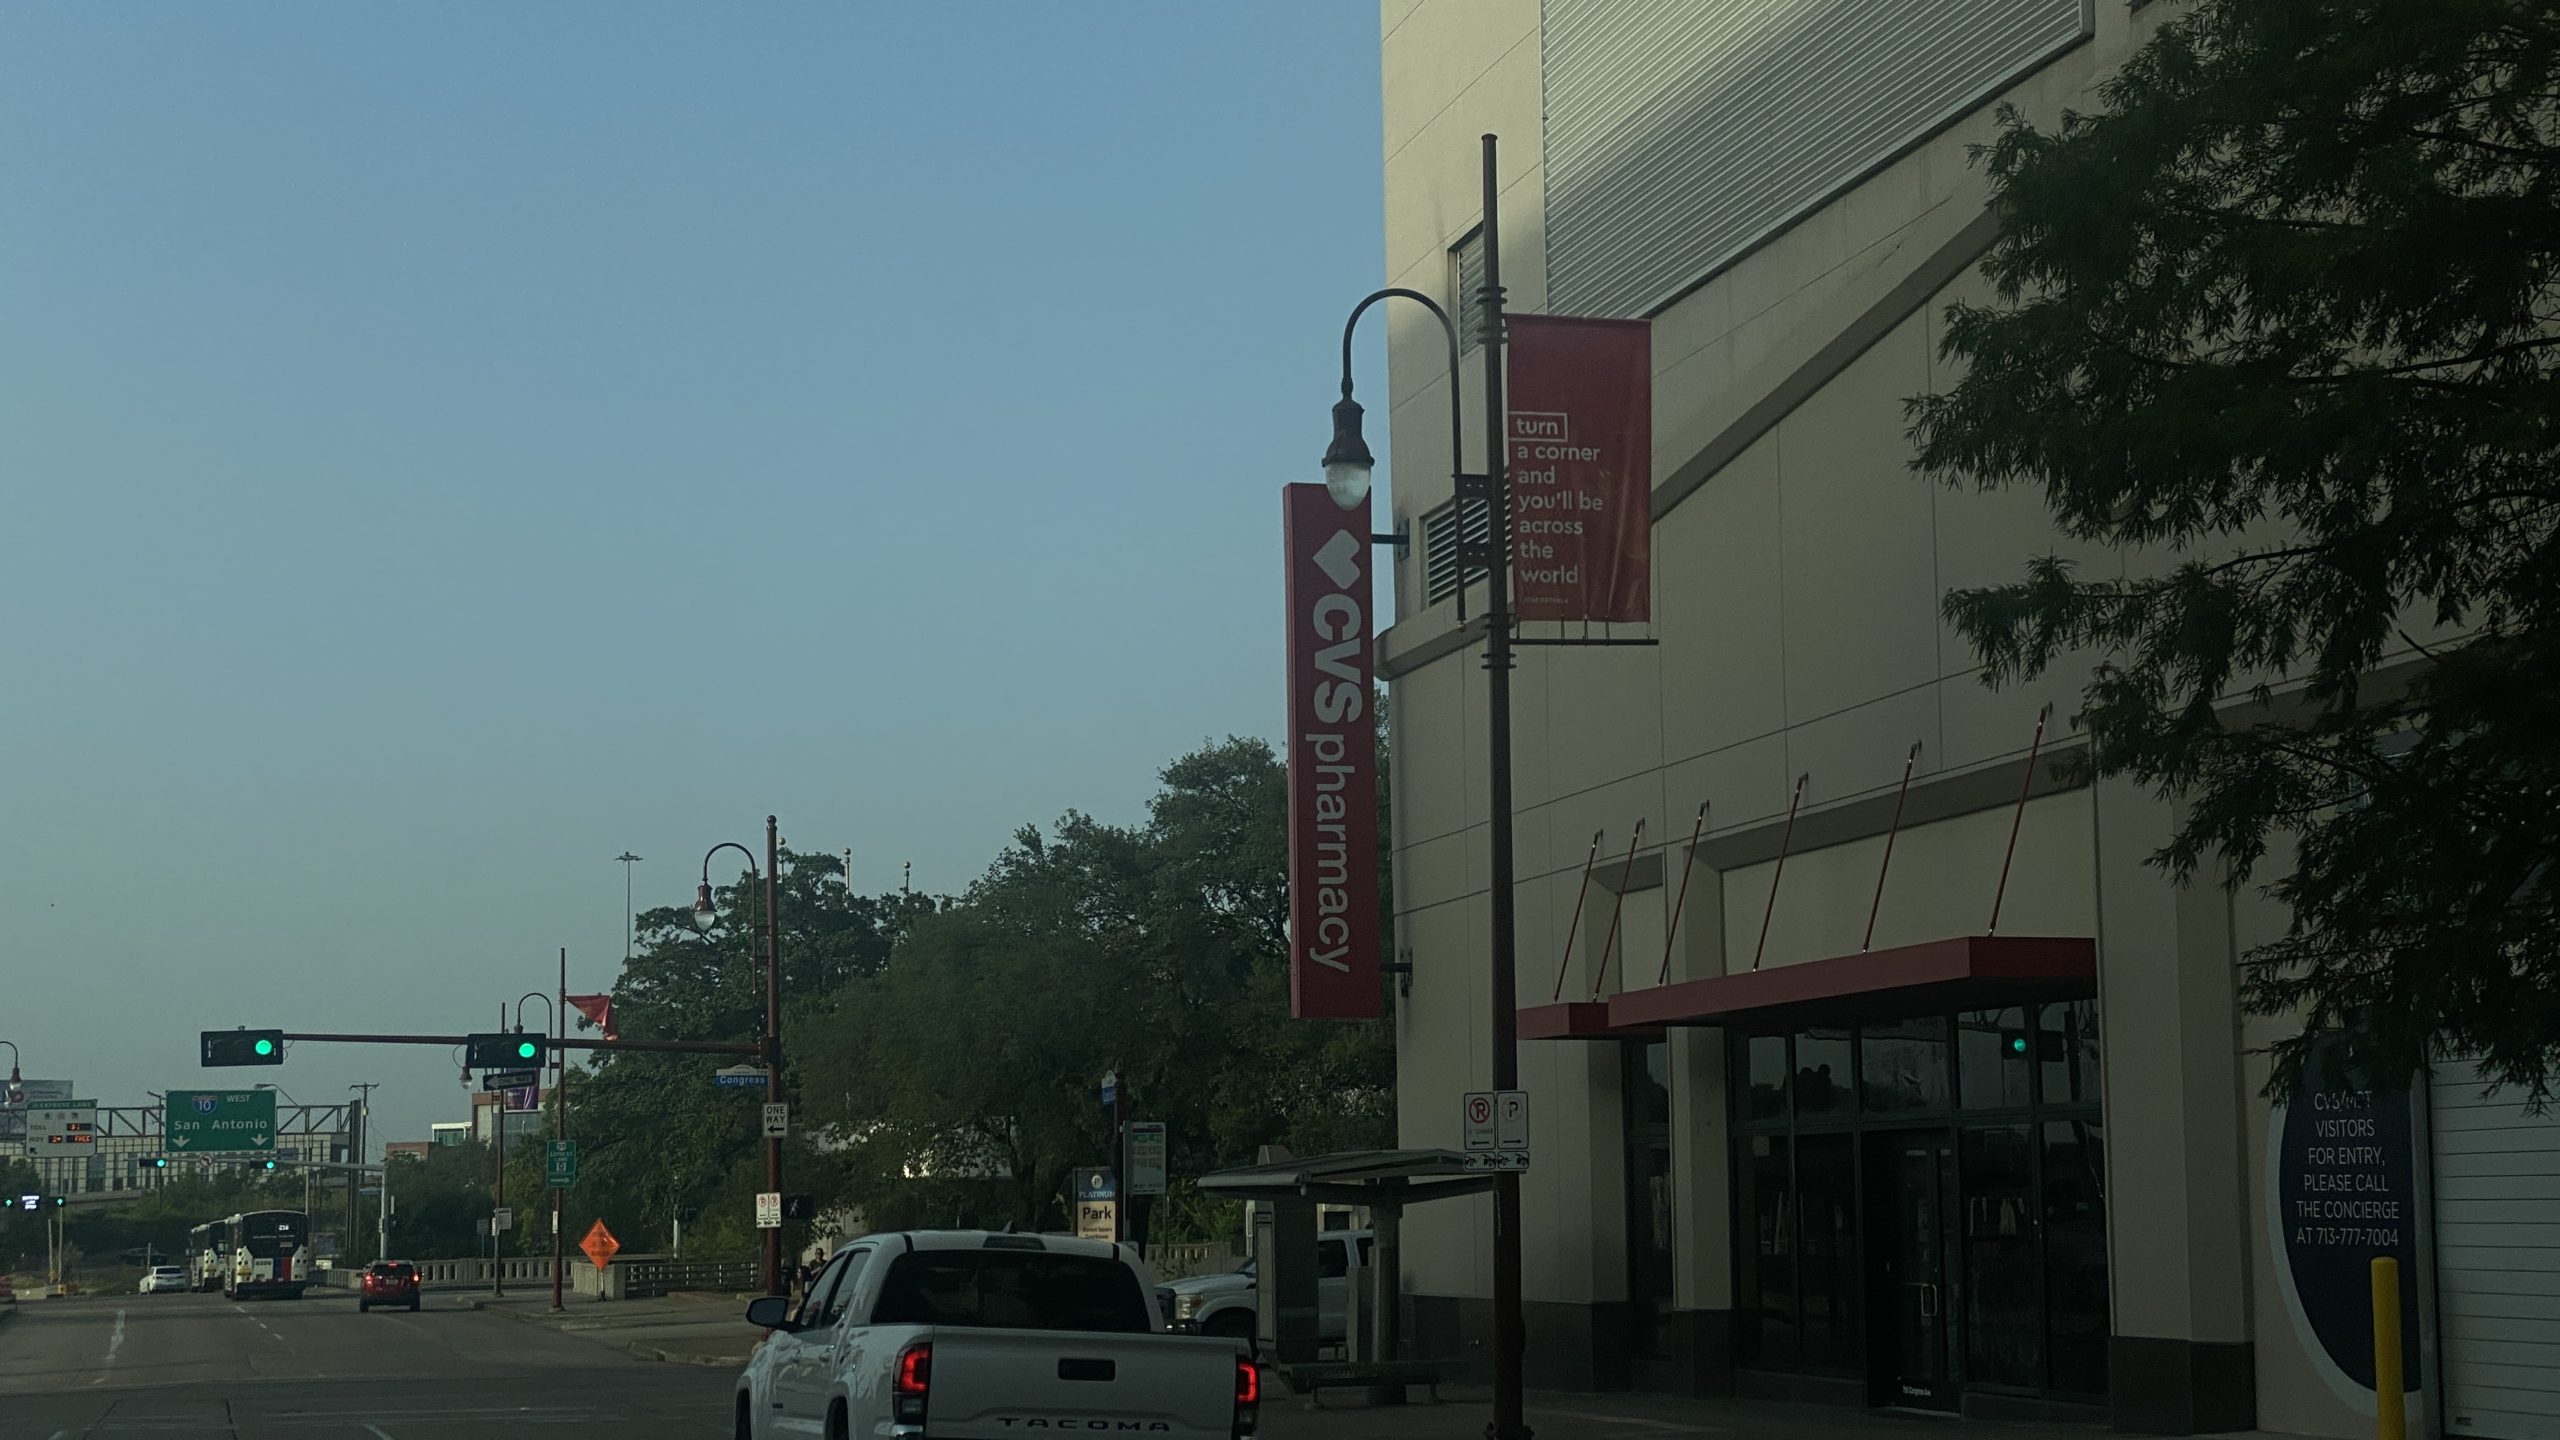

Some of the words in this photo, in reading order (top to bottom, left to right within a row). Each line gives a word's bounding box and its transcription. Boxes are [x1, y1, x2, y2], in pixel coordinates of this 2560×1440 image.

[1516, 418, 1558, 435] turn
[1517, 446, 1528, 459] a
[1535, 446, 1601, 460] corner
[1518, 465, 1555, 484] and
[1518, 491, 1572, 512] you'll
[1579, 491, 1604, 511] be
[1519, 520, 1584, 534] across
[1520, 540, 1554, 559] the
[1520, 565, 1578, 583] world
[1313, 593, 1363, 723] CVS
[1305, 734, 1355, 973] pharmacy
[720, 1076, 766, 1086] Congress
[200, 1100, 211, 1110] 10
[766, 1106, 785, 1114] ONE
[174, 1121, 200, 1130] San
[211, 1119, 268, 1130] Antonio
[766, 1115, 785, 1123] WAY
[2315, 1119, 2375, 1137] VISITORS
[2308, 1147, 2335, 1165] FOR
[2338, 1147, 2386, 1167] ENTRY,
[2303, 1174, 2352, 1191] PLEASE
[2355, 1174, 2390, 1192] CALL
[1078, 1190, 1116, 1199] PLATINUM
[1083, 1205, 1112, 1220] Park
[2296, 1200, 2321, 1218] THE
[2324, 1200, 2400, 1219] CONCIERGE
[2296, 1227, 2313, 1244] AT
[2316, 1227, 2399, 1246] 713-777-7004
[996, 1417, 1170, 1432] TACOMA
